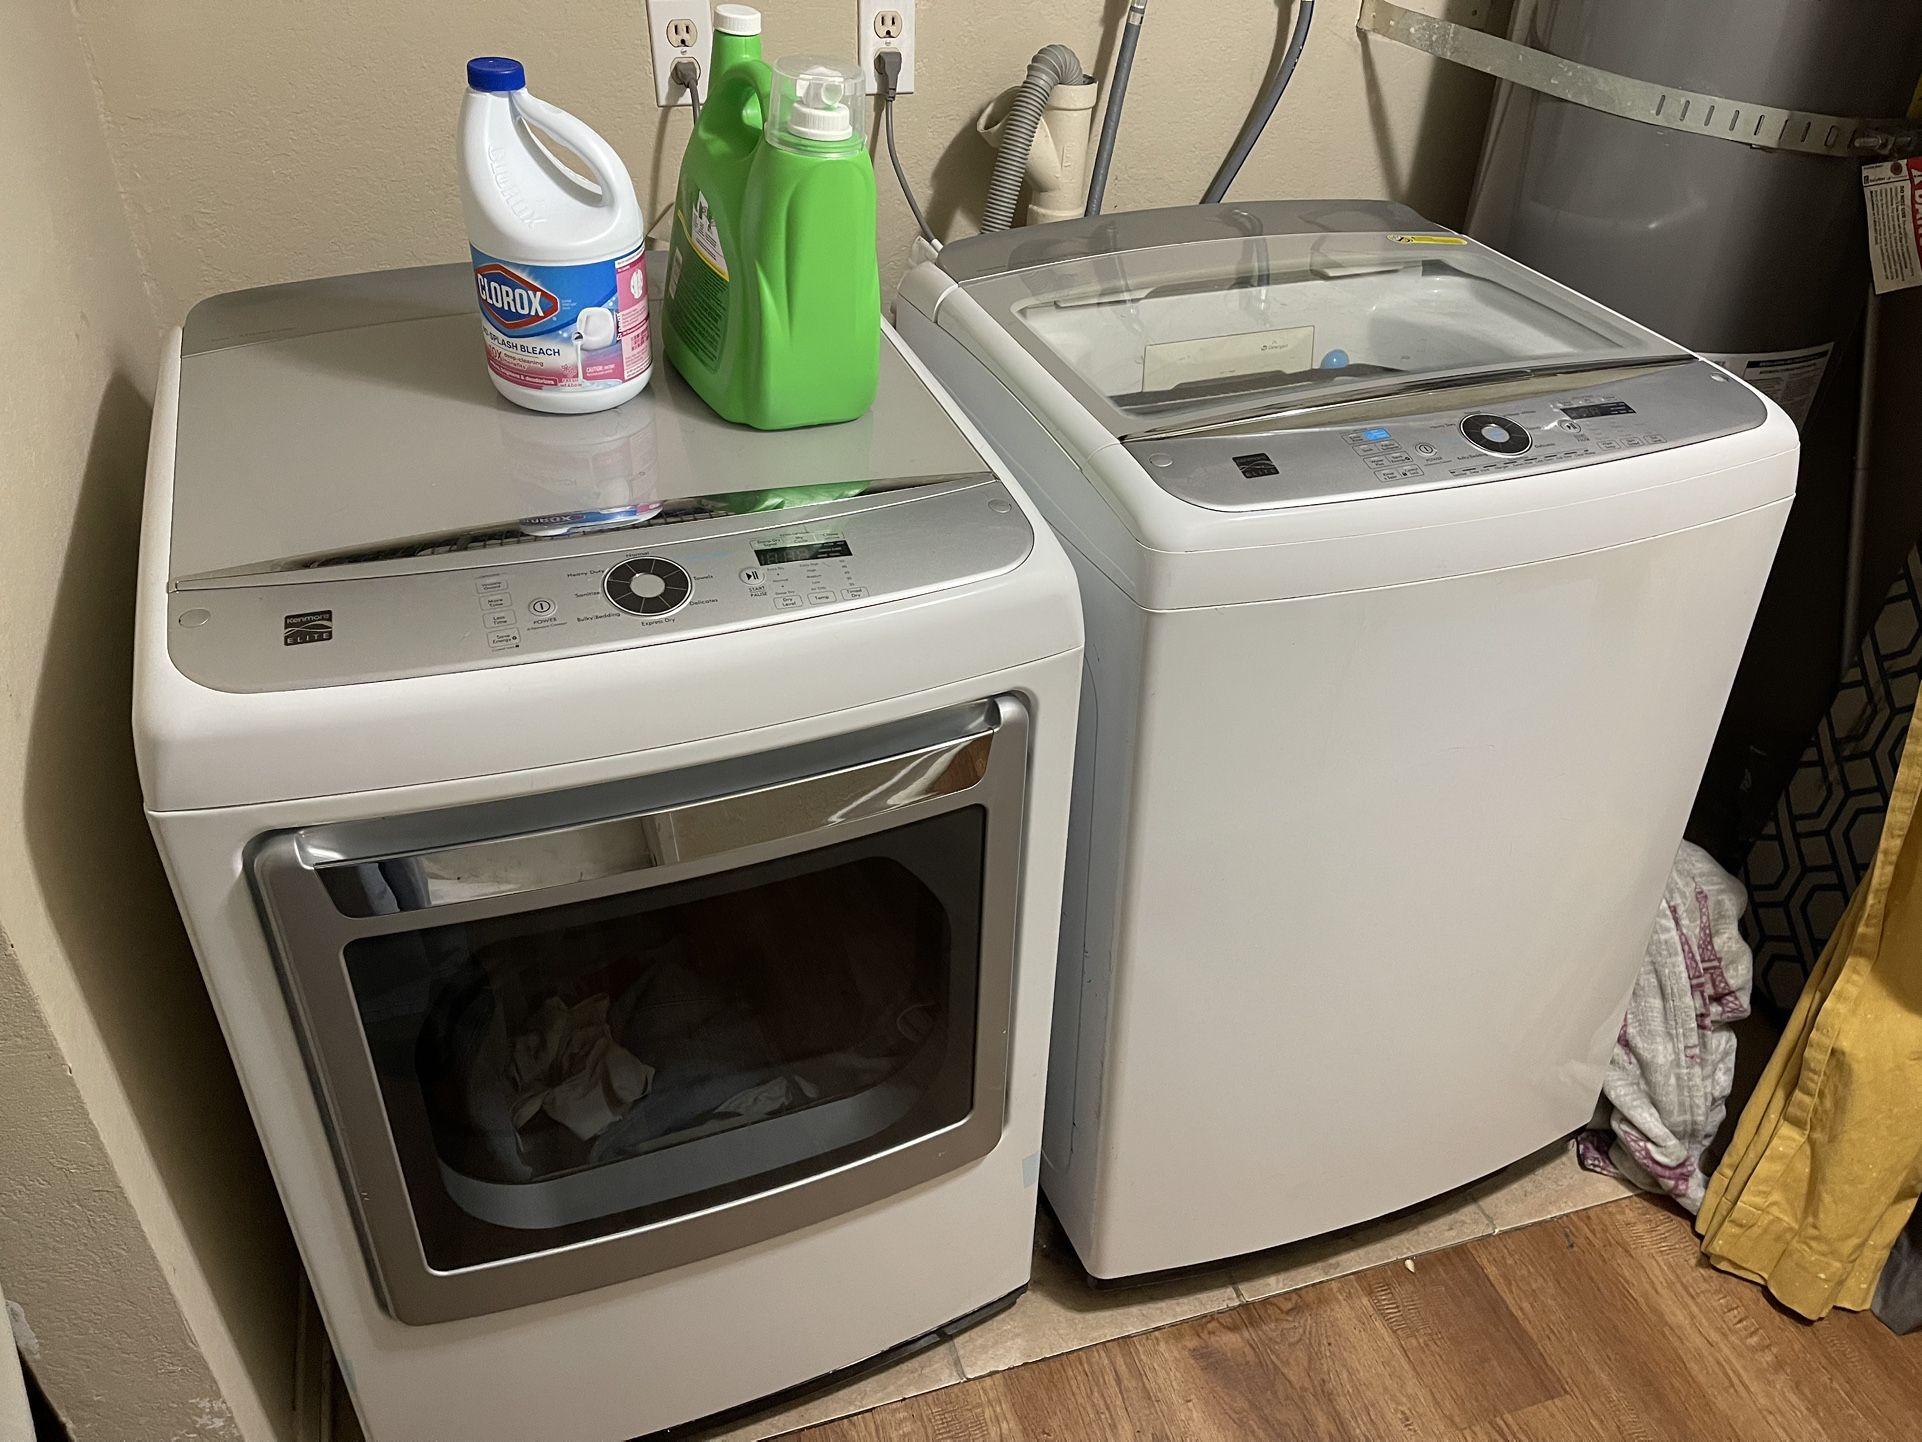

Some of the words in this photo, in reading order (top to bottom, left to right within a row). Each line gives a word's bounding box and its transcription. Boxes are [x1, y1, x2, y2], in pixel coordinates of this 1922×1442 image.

[477, 273, 545, 317] CLOROX
[520, 344, 561, 357] BLEACH
[689, 598, 719, 606] Delicates
[286, 613, 330, 624] Kenmore
[533, 617, 558, 625] POWER
[641, 619, 664, 627] Express
[286, 632, 330, 644] ELITE
